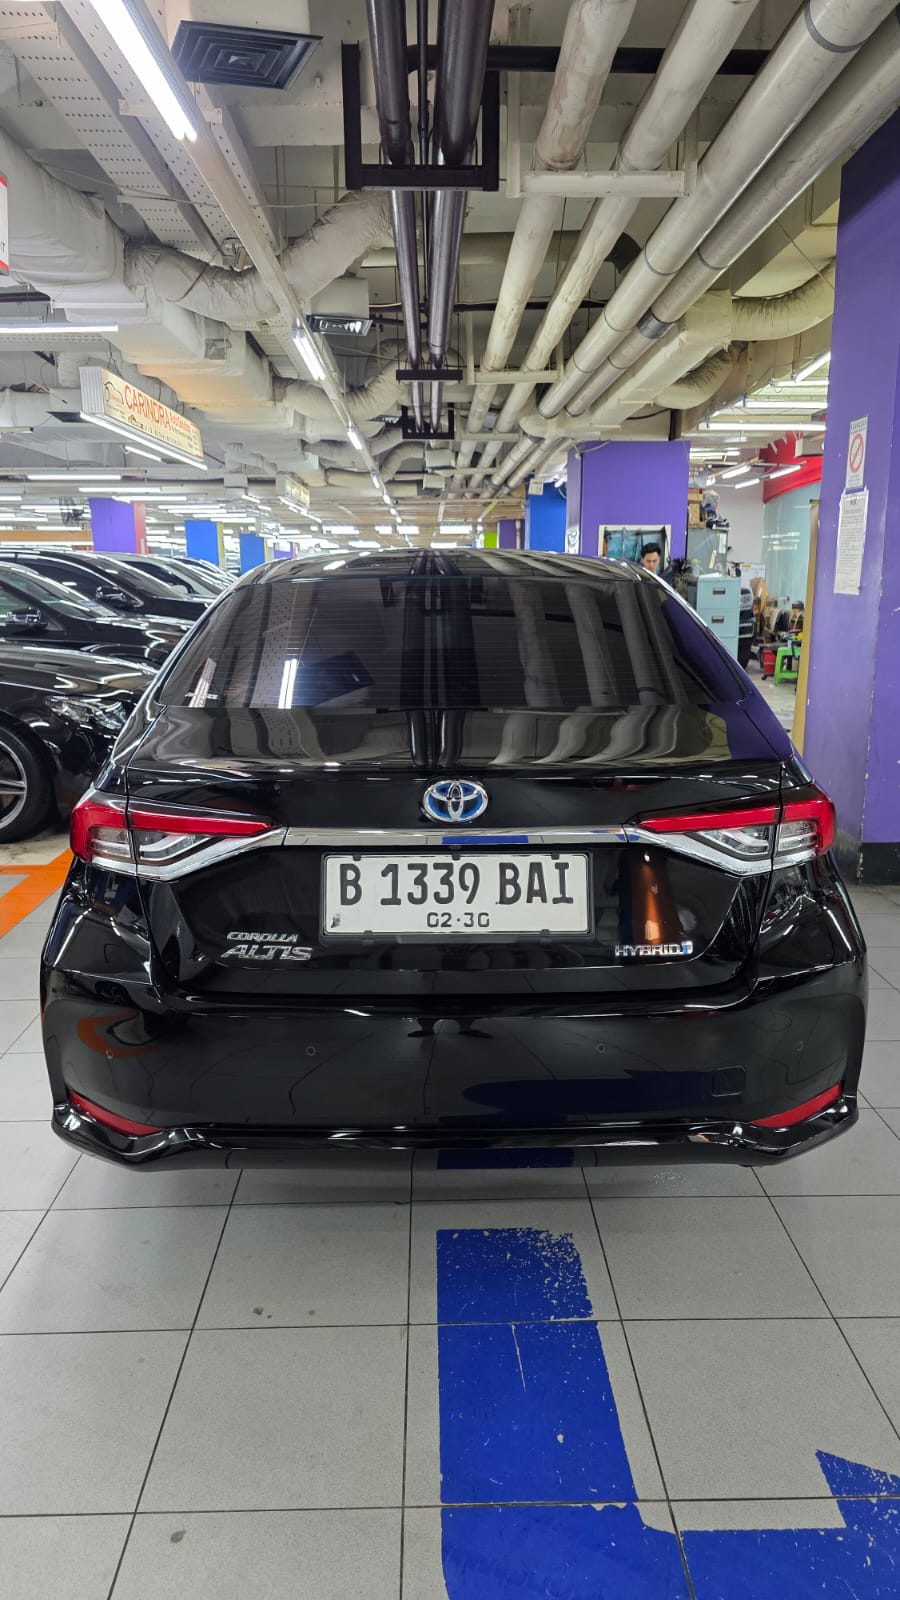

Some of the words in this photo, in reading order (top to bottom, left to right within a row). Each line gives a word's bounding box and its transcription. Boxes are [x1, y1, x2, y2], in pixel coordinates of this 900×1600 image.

[124, 385, 171, 429] CARINDRA
[339, 863, 362, 905] B
[380, 862, 480, 905] 1339
[498, 861, 574, 905] BAI
[226, 931, 299, 943] COROLLA
[220, 944, 313, 960] ALTIS
[614, 943, 681, 957] HYBRID
